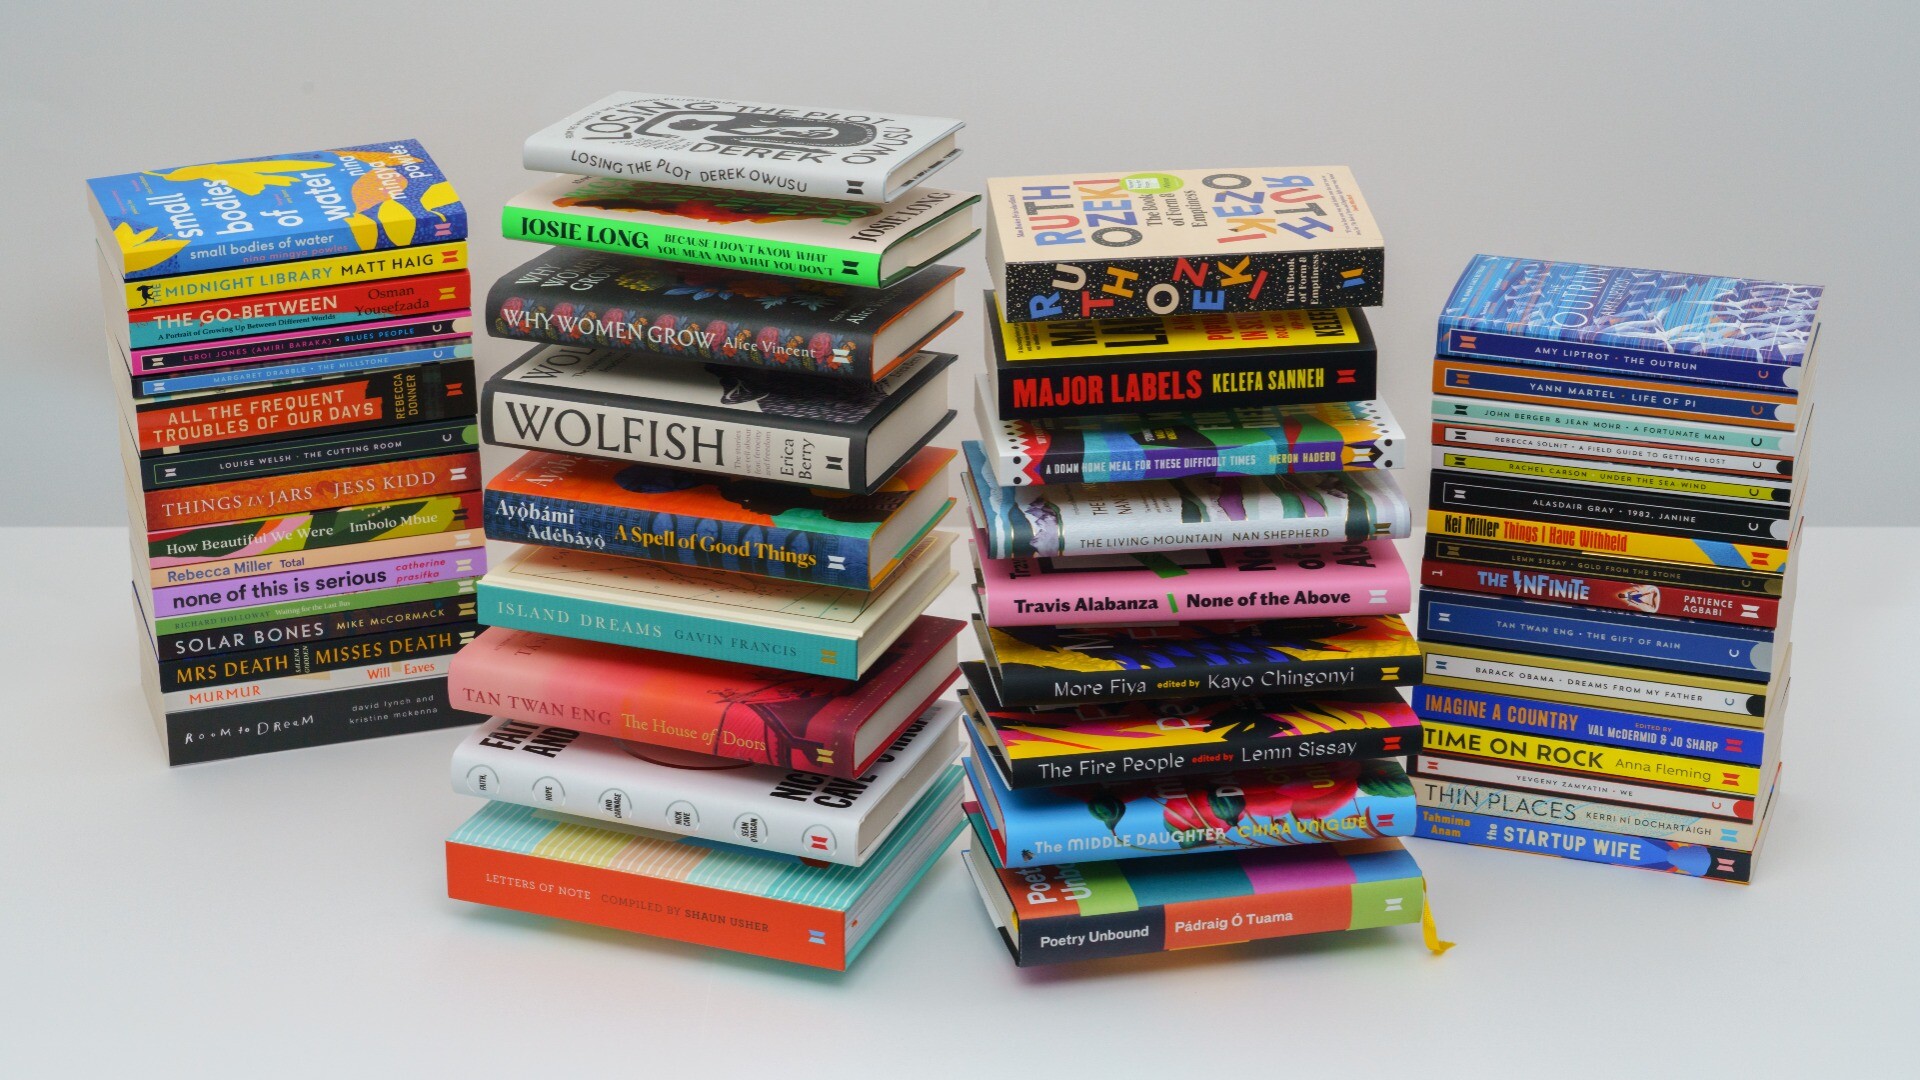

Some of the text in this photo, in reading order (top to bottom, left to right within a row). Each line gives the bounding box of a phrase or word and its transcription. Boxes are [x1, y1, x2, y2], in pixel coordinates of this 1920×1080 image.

[570, 150, 808, 193] LOSING THE PLOT DEREK OWUSU
[1021, 185, 1087, 246] RUTH
[1072, 178, 1143, 247] OZEKI
[189, 234, 335, 260] small bodies of water
[520, 217, 650, 250] JOSIE LONG
[340, 254, 435, 276] MATT HAIG
[164, 267, 333, 298] MIDNIGHT LIBRARY
[152, 294, 339, 330] THE GO-BETWEEN
[503, 308, 717, 349] WHY WOMEN GROW
[723, 338, 817, 359] Alice Vincent
[1534, 347, 1698, 370] AMY LIPTROT THE OUTRUN
[393, 373, 407, 420] REBECCA
[406, 374, 419, 416] DONNER
[1012, 367, 1325, 409] MAJOR LABELS KELEFA SANNEH
[152, 402, 374, 443] TROUBLES OF OUR DAYS
[168, 389, 345, 425] ALL THE FREQUENT
[504, 401, 726, 466] WOLFISH
[780, 438, 795, 476] Erica
[798, 438, 816, 480] Berry
[332, 471, 437, 499] JESS KIDD
[161, 495, 243, 517] THINGS
[267, 486, 313, 508] JARS
[613, 525, 818, 568] A Spell of Good Things
[1079, 528, 1330, 549] THE LIVING MOUNTAIN NAN SHEPHERD
[1444, 514, 1628, 552] Kei Miller Things I Have Withheld
[172, 571, 388, 609] none of this is serious
[1477, 571, 1509, 588] THE
[1013, 590, 1352, 614] Travis Alabanza None of the Above
[1682, 605, 1723, 617] AGBABI
[1683, 595, 1734, 609] PATIENCE
[336, 609, 446, 630] MIKE McCORMACK
[497, 601, 798, 657] ISLAND DREAMS GAVIN FRANCIS
[175, 622, 325, 655] SOLAR BONES
[315, 633, 453, 665] MISSES DEATH
[176, 655, 289, 683] MRS DEATH
[1207, 667, 1355, 691] Kayo Chingonyi
[1475, 667, 1515, 678] BARACK
[1518, 672, 1555, 683] OBAMA
[1567, 678, 1609, 690] DREAMS
[1612, 684, 1642, 694] FROM
[1664, 691, 1703, 702] FATHER
[188, 685, 262, 705] MURMUR
[1053, 678, 1201, 697] More Fiya edited by
[462, 688, 612, 725] TAN TWAN ENG
[1424, 694, 1579, 732] IMAGINE A COUNTRY
[621, 713, 766, 751] The House of Doors
[1587, 724, 1719, 753] VAL McDERMID & JO SHARP
[1634, 723, 1661, 731] EDITED
[1424, 727, 1604, 769] TIME ON ROCK
[1614, 758, 1712, 783] Anna Fleming
[1422, 811, 1471, 828] Tahmima
[1424, 783, 1480, 807] THIN
[1488, 792, 1577, 821] PLACES
[1585, 811, 1617, 822] KERRI
[1634, 818, 1712, 836] DOCHARTAIGH
[1034, 827, 1227, 854] The MIDDLE DAUGHTER
[1237, 822, 1291, 838] CHIKA
[1430, 825, 1462, 838] Anam
[1485, 823, 1642, 861] the STARTUP WIFE
[485, 873, 591, 900] LETTERS OF NOTE
[1039, 926, 1150, 948] Poetry Unbound
[1174, 912, 1294, 933] Pádraig Ó Tuama
